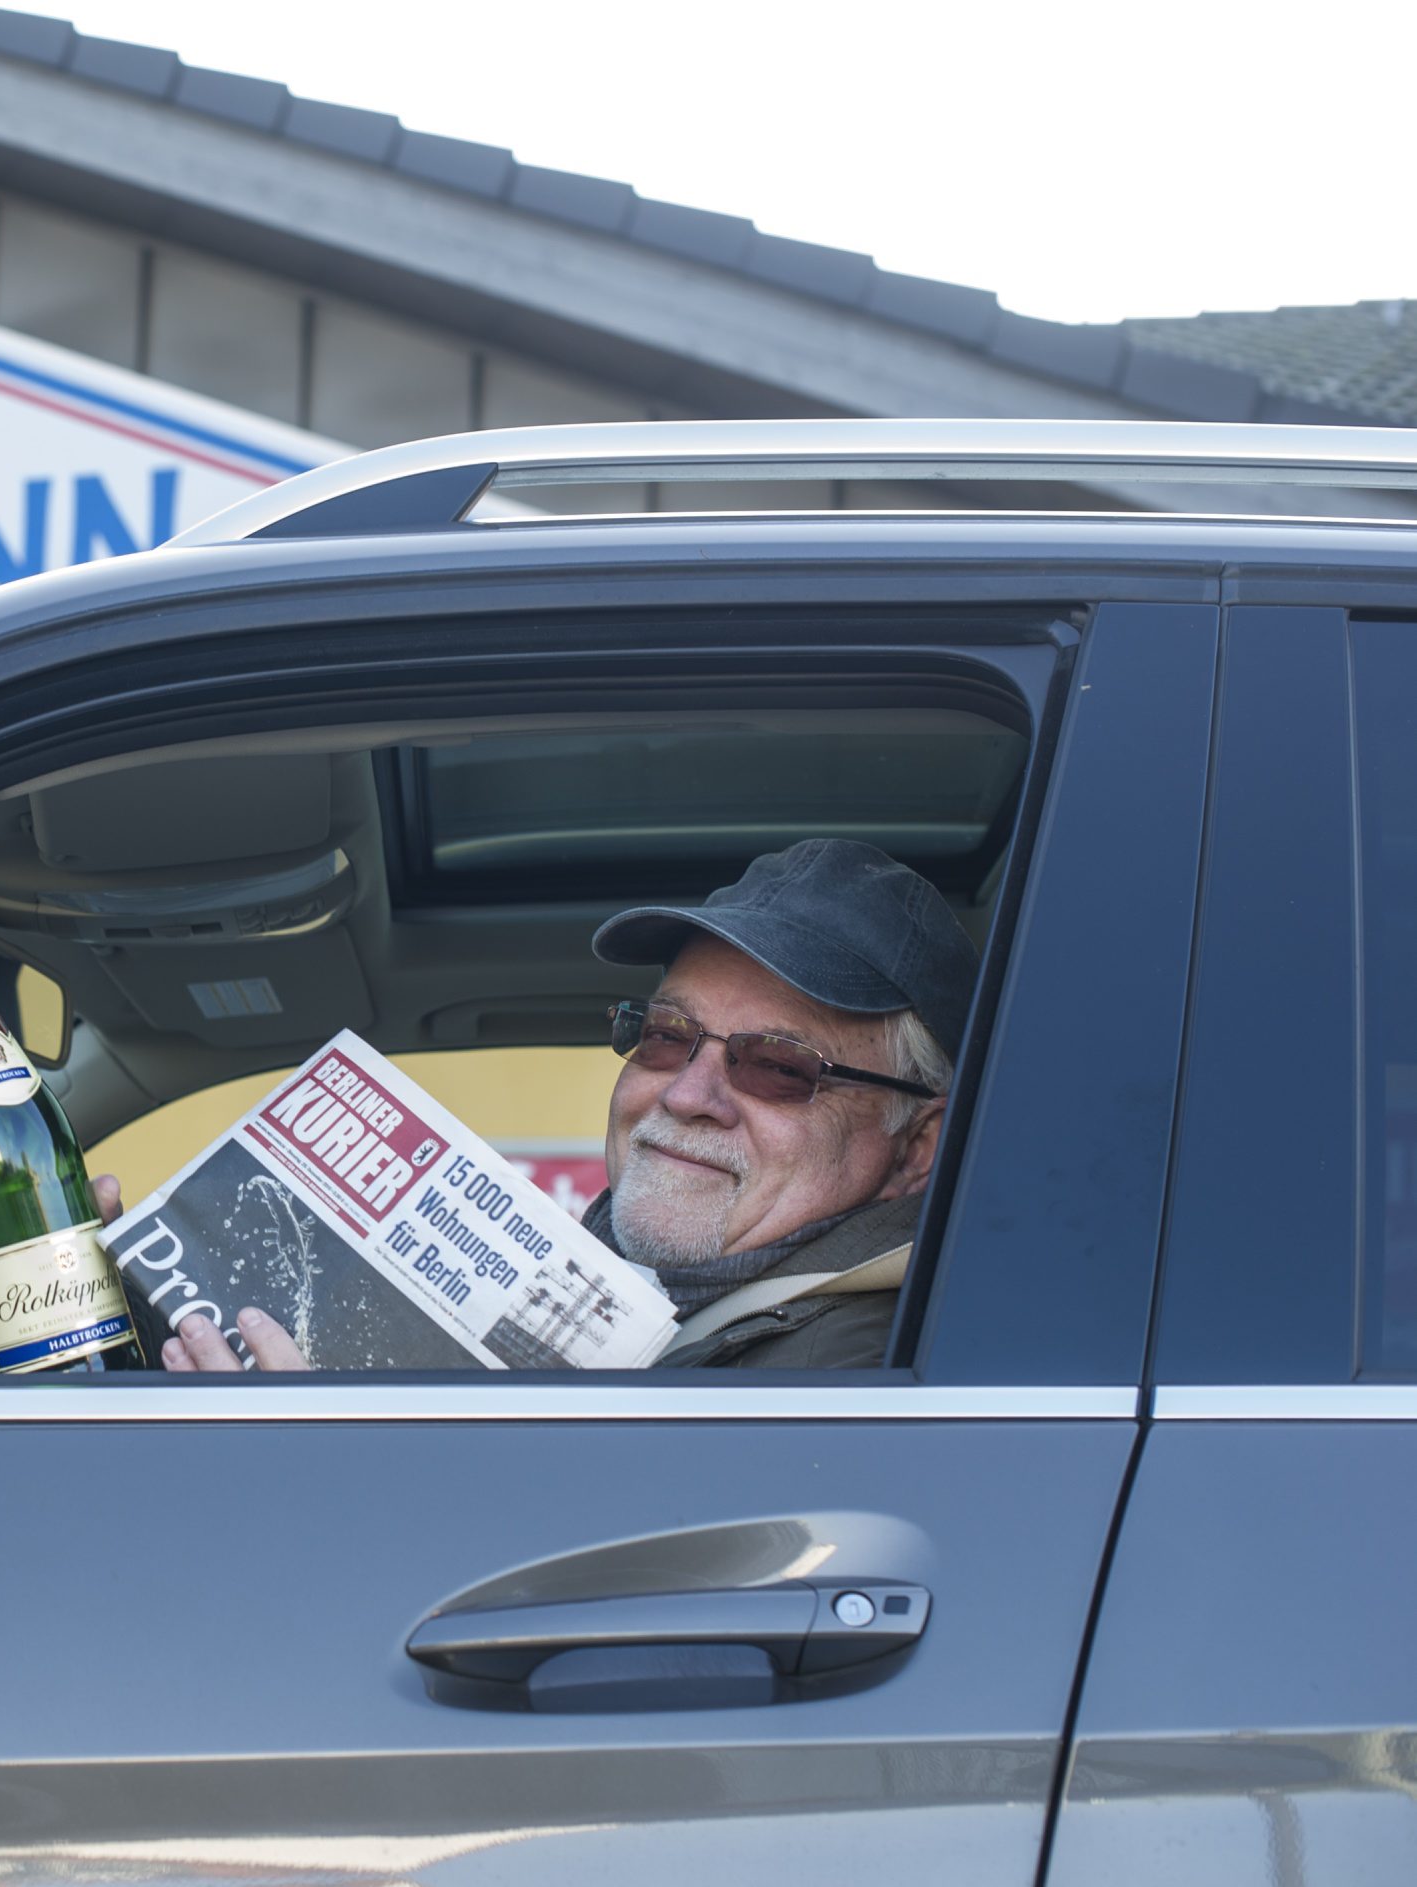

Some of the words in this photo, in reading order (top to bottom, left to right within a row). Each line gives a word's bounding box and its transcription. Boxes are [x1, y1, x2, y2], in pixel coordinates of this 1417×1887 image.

[312, 1056, 404, 1138] BERLINER
[269, 1077, 414, 1213] KURIER
[384, 1220, 420, 1258] für
[412, 1243, 472, 1307] Berlin
[414, 1185, 519, 1290] Wohnungen
[502, 1212, 553, 1260] neue
[48, 1321, 122, 1351] HALBTROCKEN
